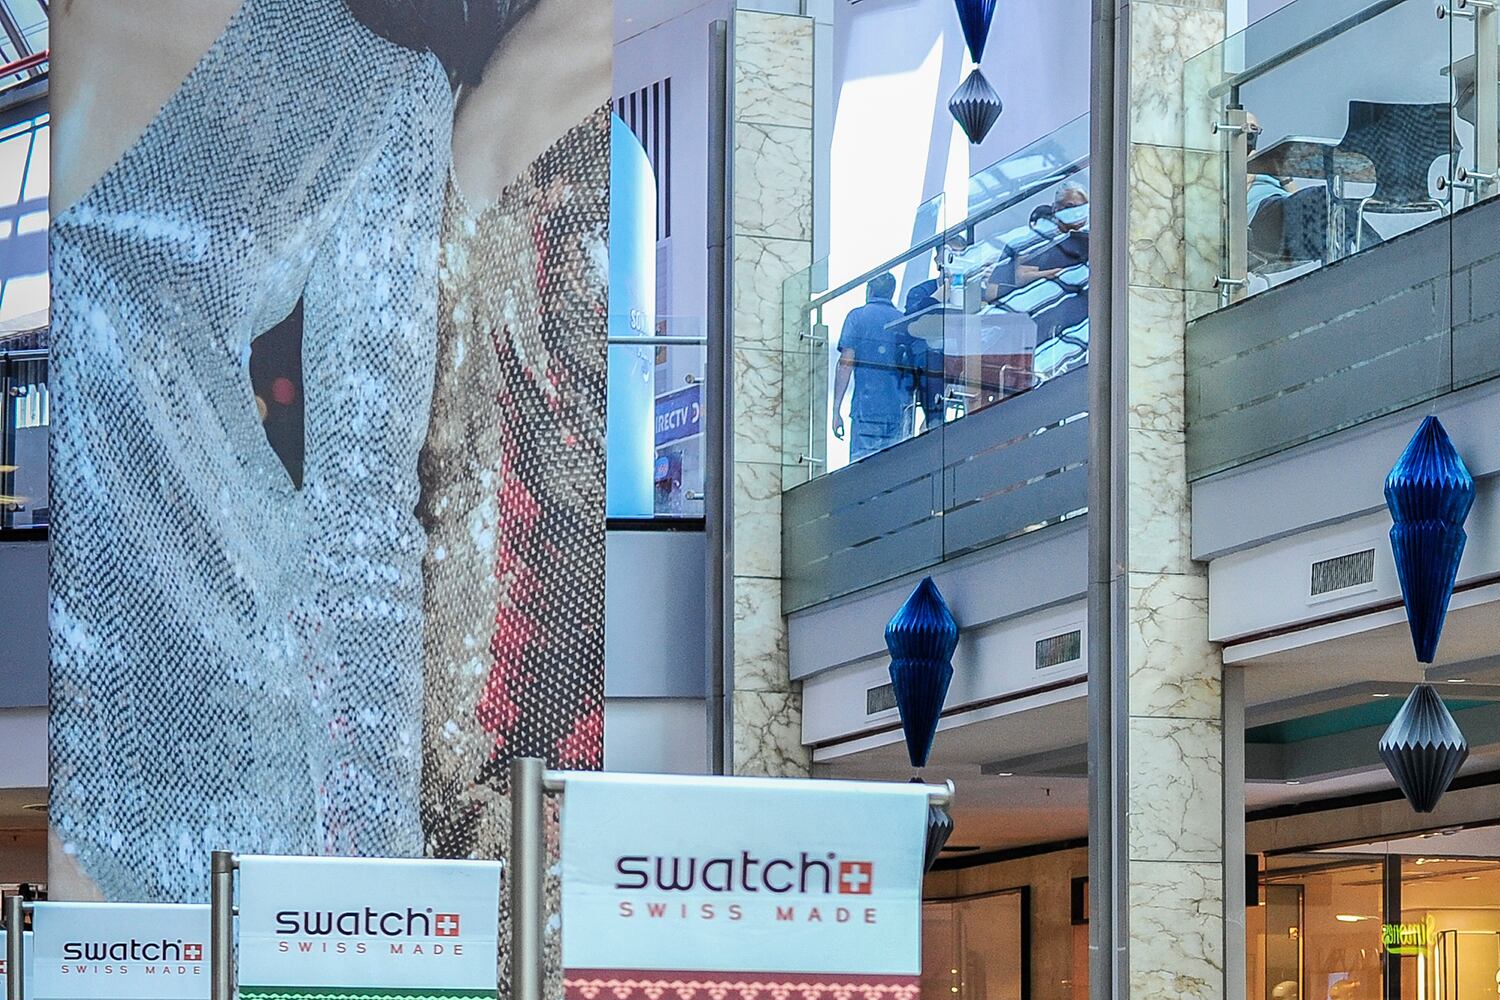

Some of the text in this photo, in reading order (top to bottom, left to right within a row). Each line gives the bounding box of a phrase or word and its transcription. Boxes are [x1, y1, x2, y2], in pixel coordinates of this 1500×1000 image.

[656, 405, 689, 433] IRECTV
[614, 851, 831, 893] swatch
[276, 907, 430, 936] swatch
[619, 902, 877, 923] SWISS MADE
[63, 939, 180, 961] swatch
[278, 941, 463, 955] SWISS MADE
[61, 965, 201, 975] SWISS MADE
